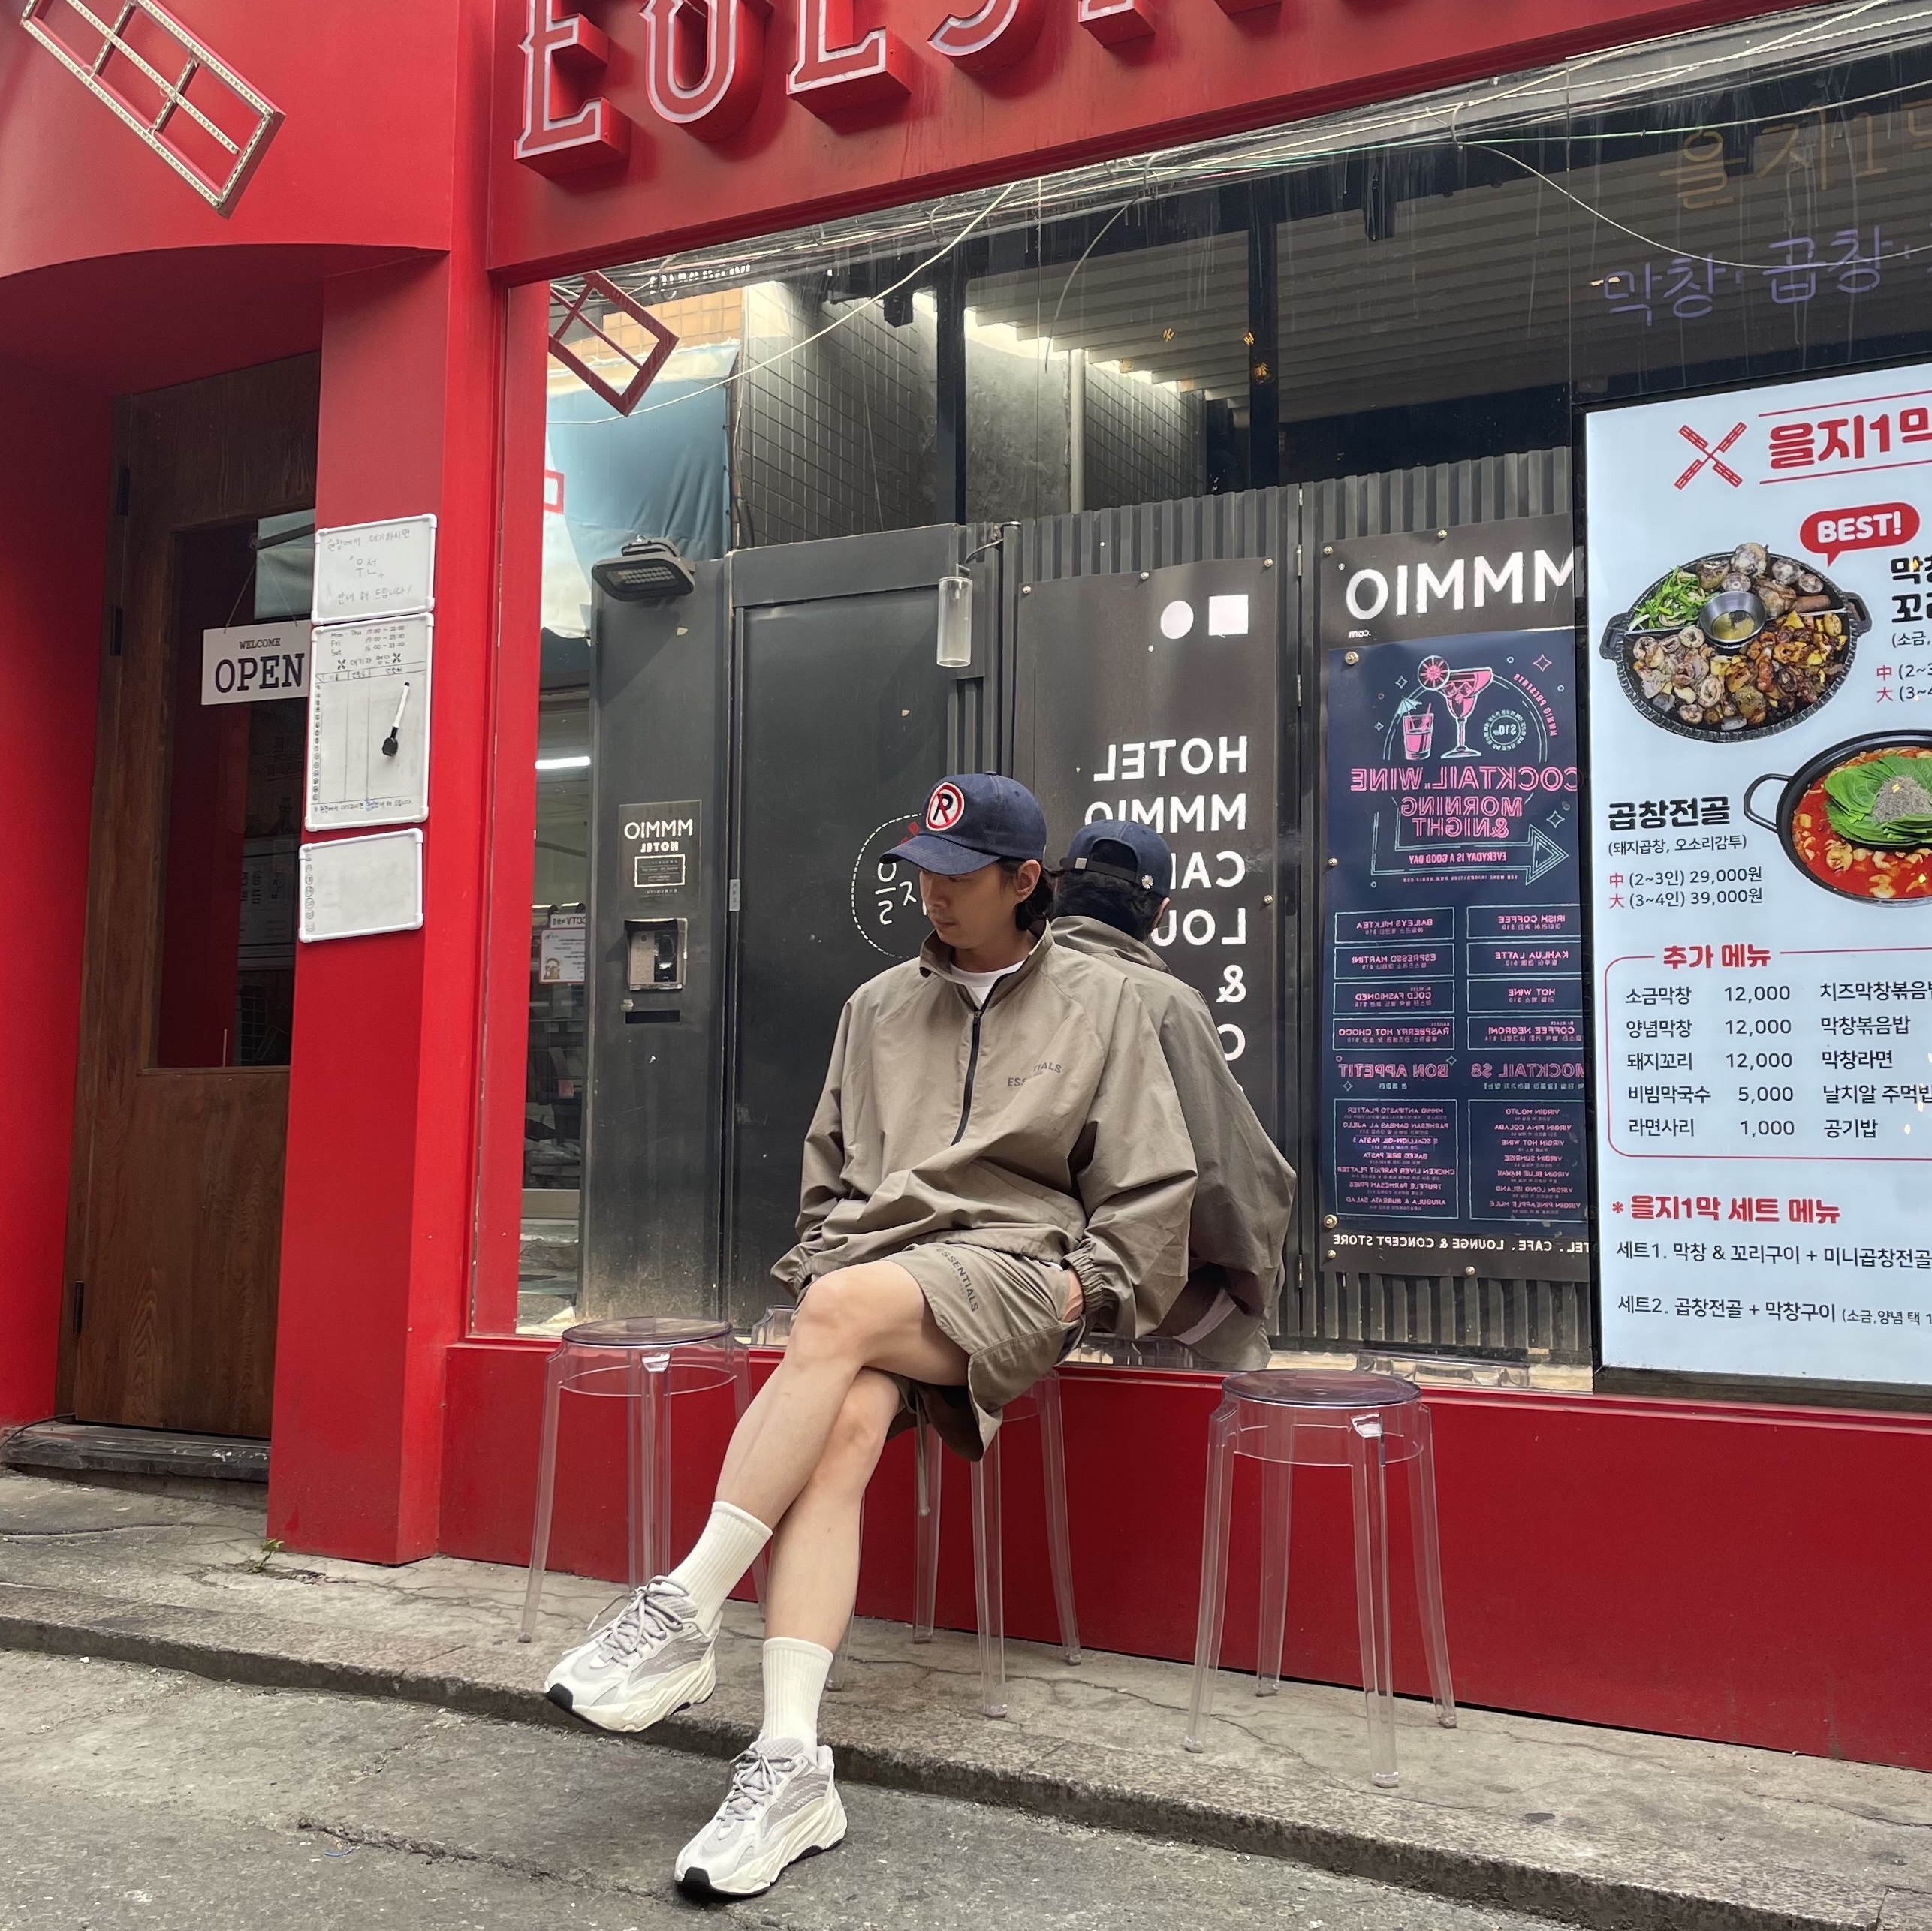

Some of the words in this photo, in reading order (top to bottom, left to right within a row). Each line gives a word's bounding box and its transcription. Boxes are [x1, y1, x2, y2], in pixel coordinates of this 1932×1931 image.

[1817, 511, 1901, 544] BEST!
[1891, 556, 1932, 585] 막
[239, 638, 281, 649] WELCOME
[216, 653, 305, 694] OPEN
[1876, 664, 1892, 681] 中
[1876, 687, 1893, 703] 大
[1608, 796, 1731, 832] 곱창전골
[1608, 839, 1671, 856] (돼지곱창,
[1674, 834, 1747, 853] 오소리감투)
[1609, 872, 1624, 888] 中
[1629, 869, 1685, 887] (2~3인)
[1690, 866, 1763, 886] 29,000원
[1608, 894, 1625, 910] 大
[1629, 891, 1686, 910] (3~4인)
[1690, 888, 1763, 907] 39,000원
[1662, 944, 1713, 969] 추가
[1721, 944, 1771, 969] 메뉴
[1625, 986, 1692, 1005] 소금막창
[1724, 985, 1791, 1004] 12,000
[1626, 1019, 1693, 1039] 양념막창
[1726, 1019, 1792, 1037] 12,000
[1821, 1015, 1911, 1035] 막창볶음밥
[1626, 1051, 1693, 1071] 돼지꼬리
[1726, 1052, 1793, 1071] 12,000
[1822, 1050, 1893, 1070] 막창라면
[1628, 1086, 1711, 1104] 비빔막국수
[1738, 1086, 1794, 1104] 5,000
[1823, 1084, 1877, 1104] 날치알
[1629, 1119, 1695, 1138] 라면사리
[1740, 1120, 1795, 1138] 1,000
[1824, 1119, 1878, 1138] 공기밥
[1631, 1195, 1721, 1222] 을지1막
[1728, 1197, 1780, 1222] 세트
[1789, 1198, 1841, 1224] 메뉴
[1617, 1241, 1668, 1260] 세트1.
[1673, 1243, 1707, 1263] 막창
[1713, 1246, 1726, 1260] &
[1731, 1245, 1800, 1264] 꼬리구이
[1824, 1247, 1932, 1269] 미니곱창전골
[936, 1248, 979, 1312] ESSENTIALS
[1618, 1295, 1668, 1315] 세트2.
[1674, 1299, 1743, 1319] 곱창전골
[1765, 1302, 1836, 1323] 막창구이
[1843, 1309, 1903, 1325] (소금,양념
[1907, 1311, 1921, 1326] 택
